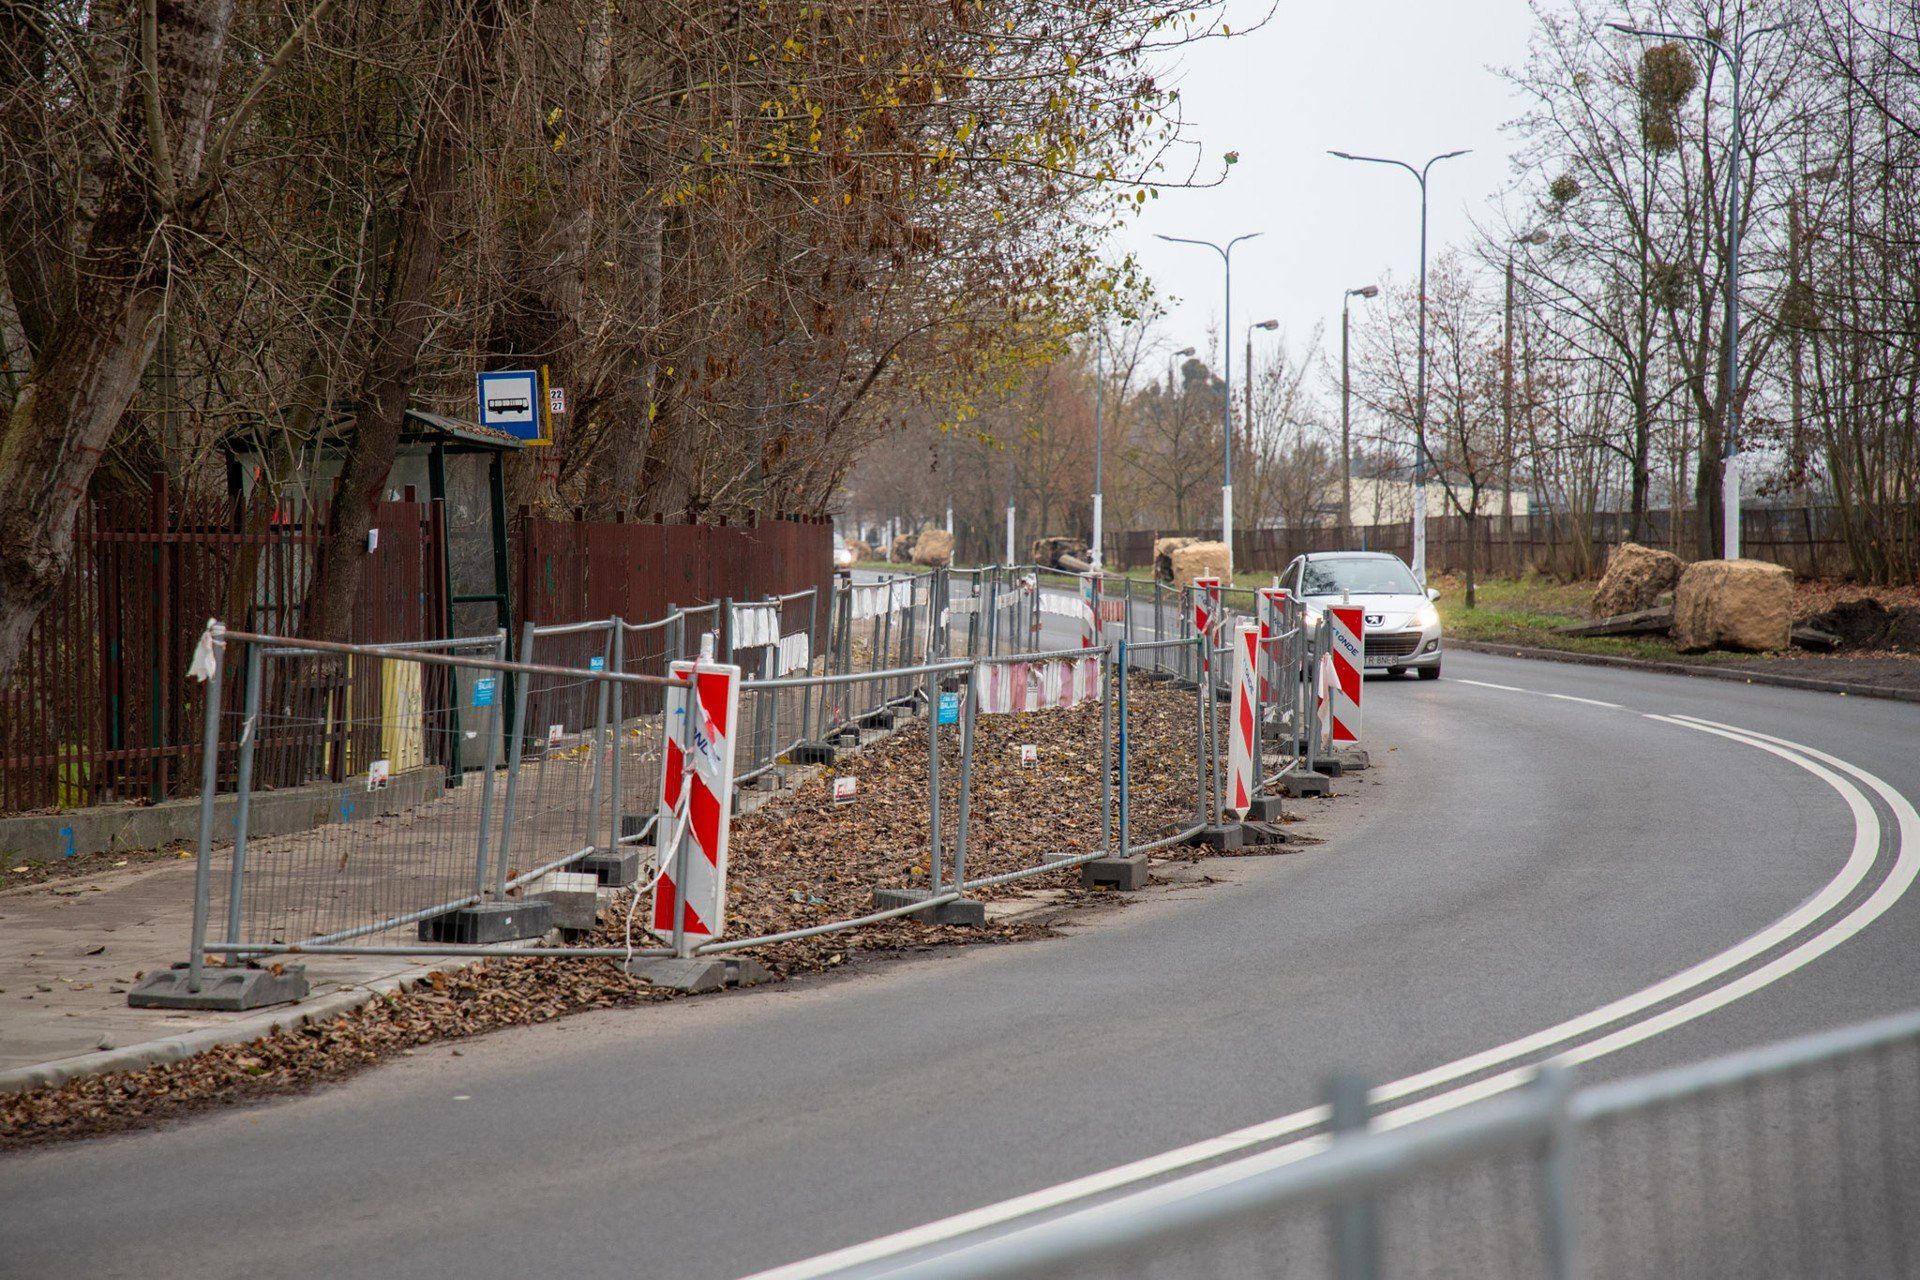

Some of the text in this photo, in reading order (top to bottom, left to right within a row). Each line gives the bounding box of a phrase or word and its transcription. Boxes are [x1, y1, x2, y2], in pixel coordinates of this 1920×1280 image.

[550, 390, 562, 399] 22
[552, 402, 562, 411] 27
[1337, 634, 1359, 657] ONDE
